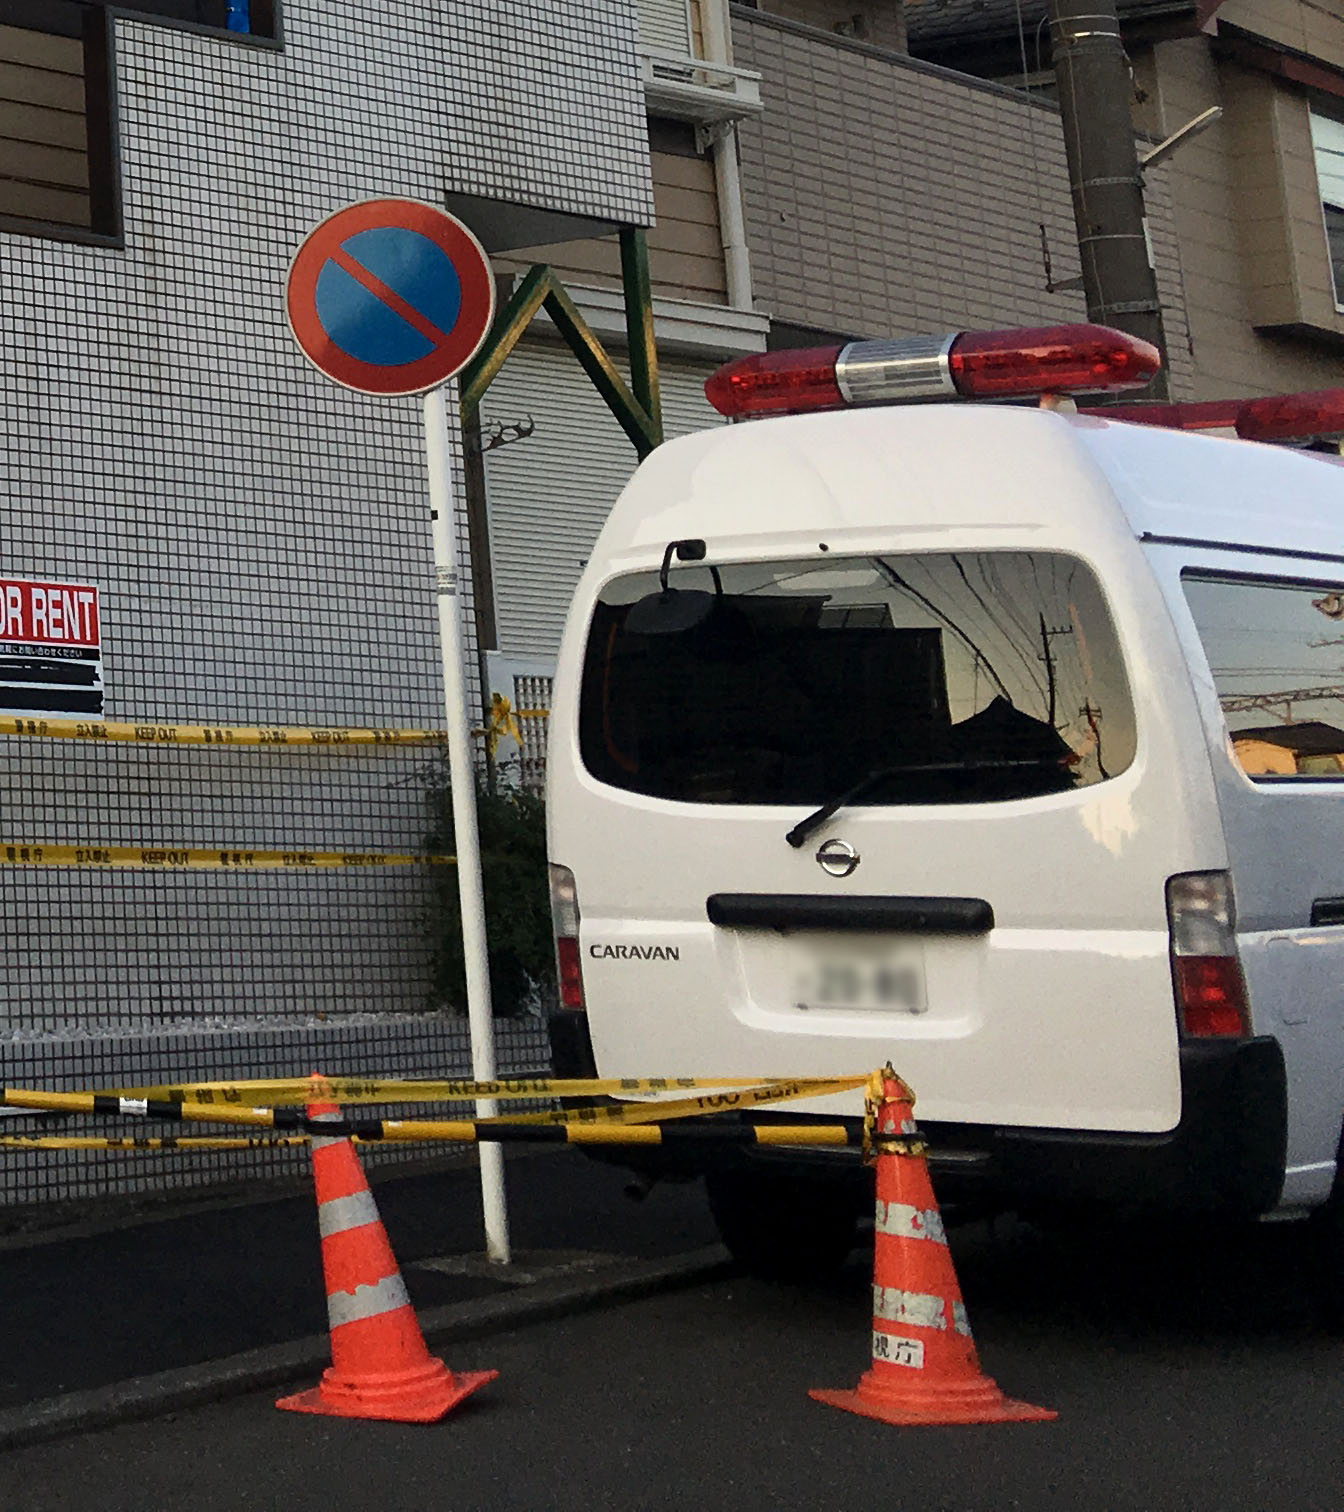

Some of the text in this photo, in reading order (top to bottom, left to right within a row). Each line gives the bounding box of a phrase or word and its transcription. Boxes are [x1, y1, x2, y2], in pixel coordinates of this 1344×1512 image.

[31, 587, 95, 641] RENT
[134, 726, 157, 740] KEEP
[157, 727, 178, 741] OUT
[141, 851, 167, 865] KEEP
[167, 852, 189, 866] OUT
[589, 943, 681, 961] CARAVAN
